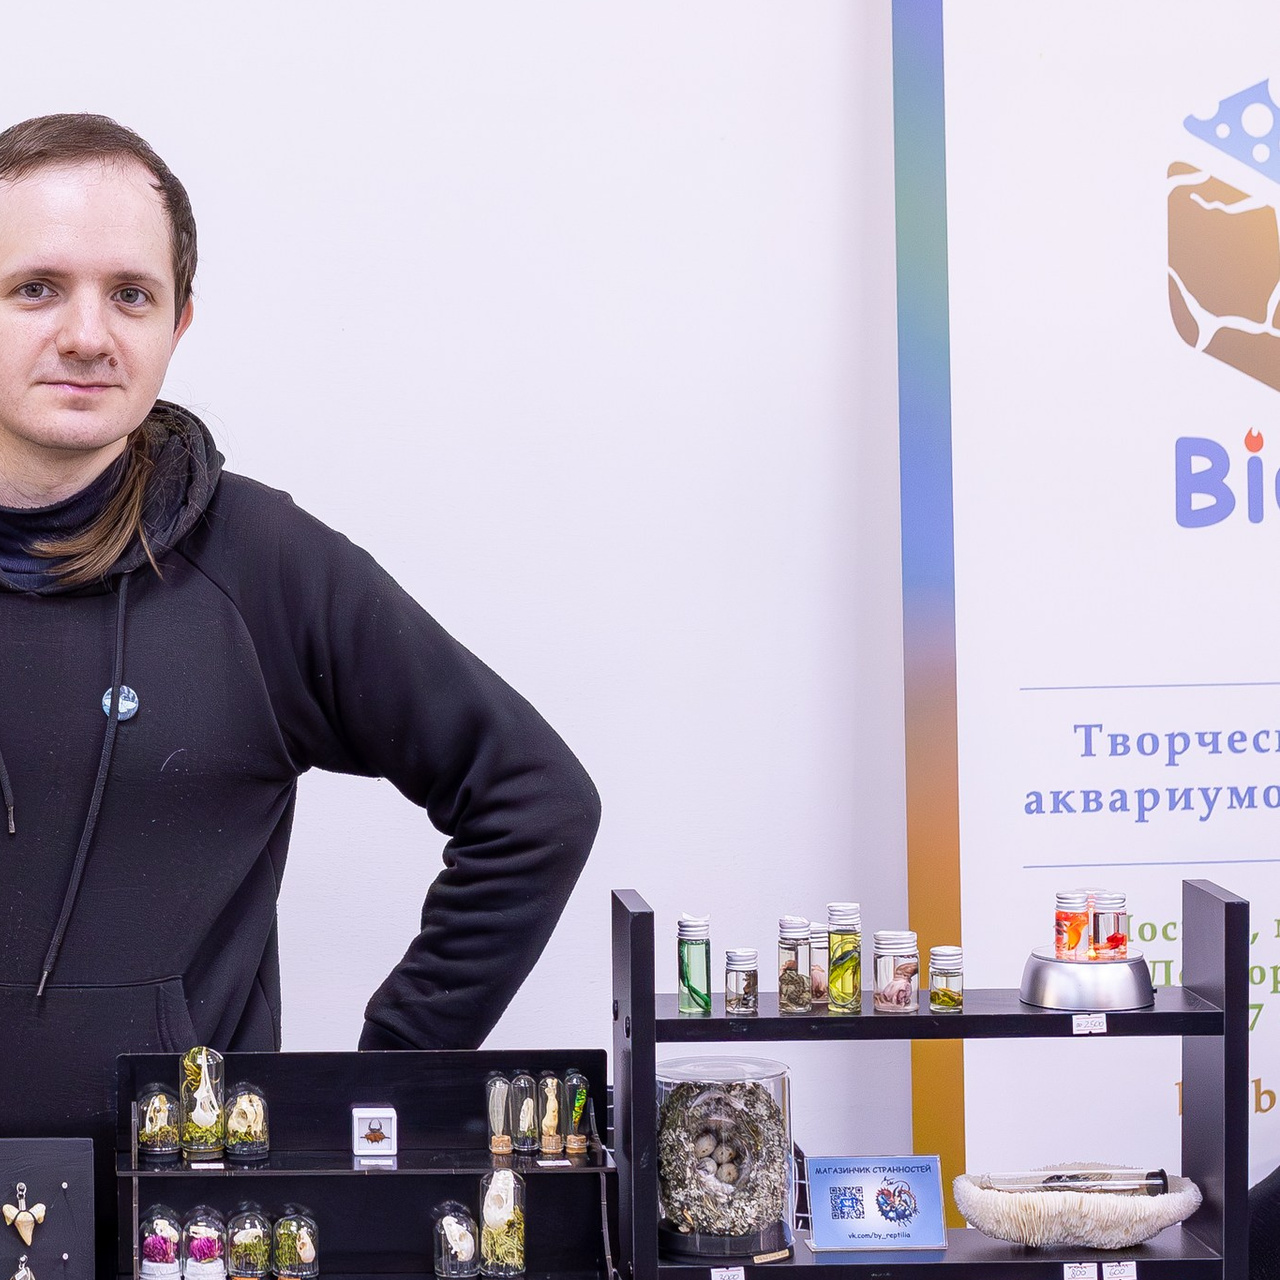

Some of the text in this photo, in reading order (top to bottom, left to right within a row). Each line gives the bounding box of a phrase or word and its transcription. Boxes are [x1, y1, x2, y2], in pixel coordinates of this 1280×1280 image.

[1175, 427, 1280, 529] Bi
[1073, 722, 1280, 767] Творчес
[814, 1164, 932, 1175] МАГАЗИНЧИК СТРАННОСТЕЙ
[847, 1231, 911, 1241] vk.com/by_reptilia
[1070, 1269, 1087, 1279] 800
[1109, 1267, 1126, 1277] 600
